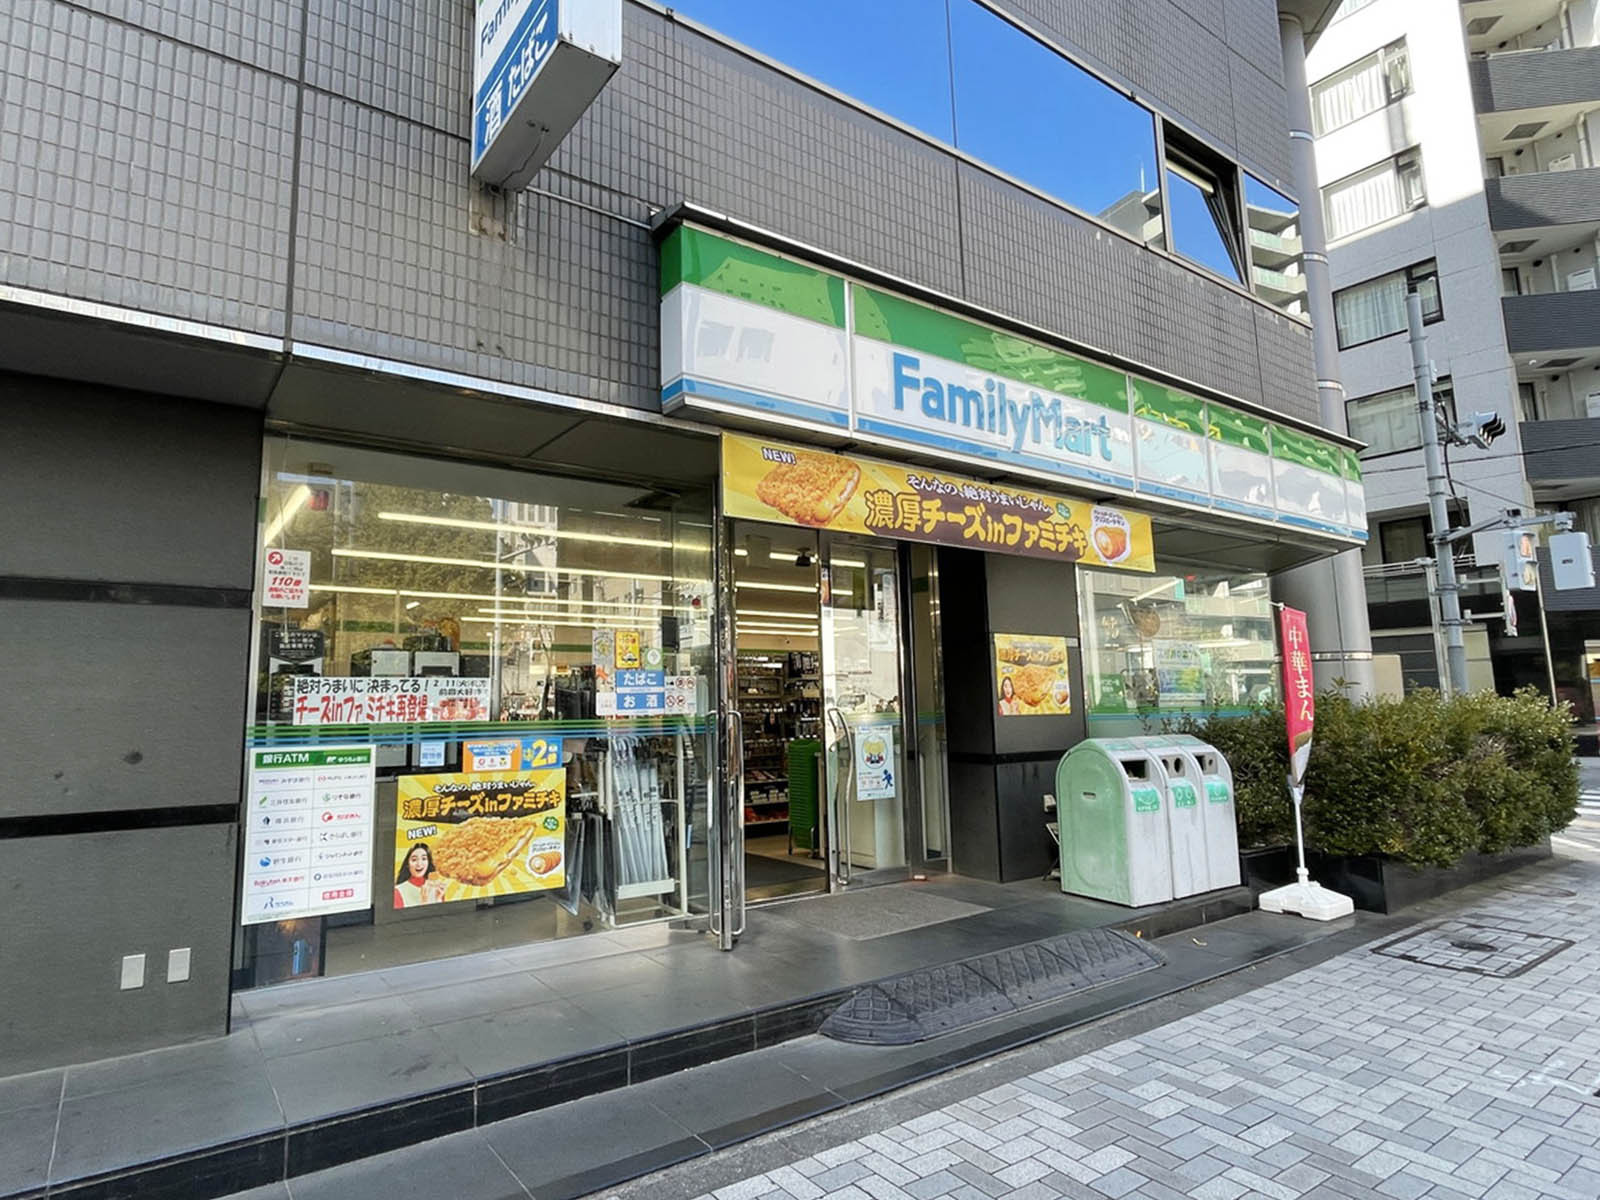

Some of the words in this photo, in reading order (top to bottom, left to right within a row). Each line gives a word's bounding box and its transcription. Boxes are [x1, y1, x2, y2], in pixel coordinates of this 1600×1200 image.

[484, 80, 503, 145] 酒
[507, 11, 549, 107] たばこ
[892, 351, 1113, 462] FamilyMart
[762, 447, 797, 465] NEW!
[865, 489, 1088, 557] 濃厚チーズinファミチキ
[623, 672, 657, 686] たばこ
[1288, 625, 1314, 721] 中華まん
[295, 695, 429, 724] チーズinファミチキ再登場
[402, 789, 561, 820] 濃厚チーズinファミチキ
[407, 825, 437, 840] NEW!
